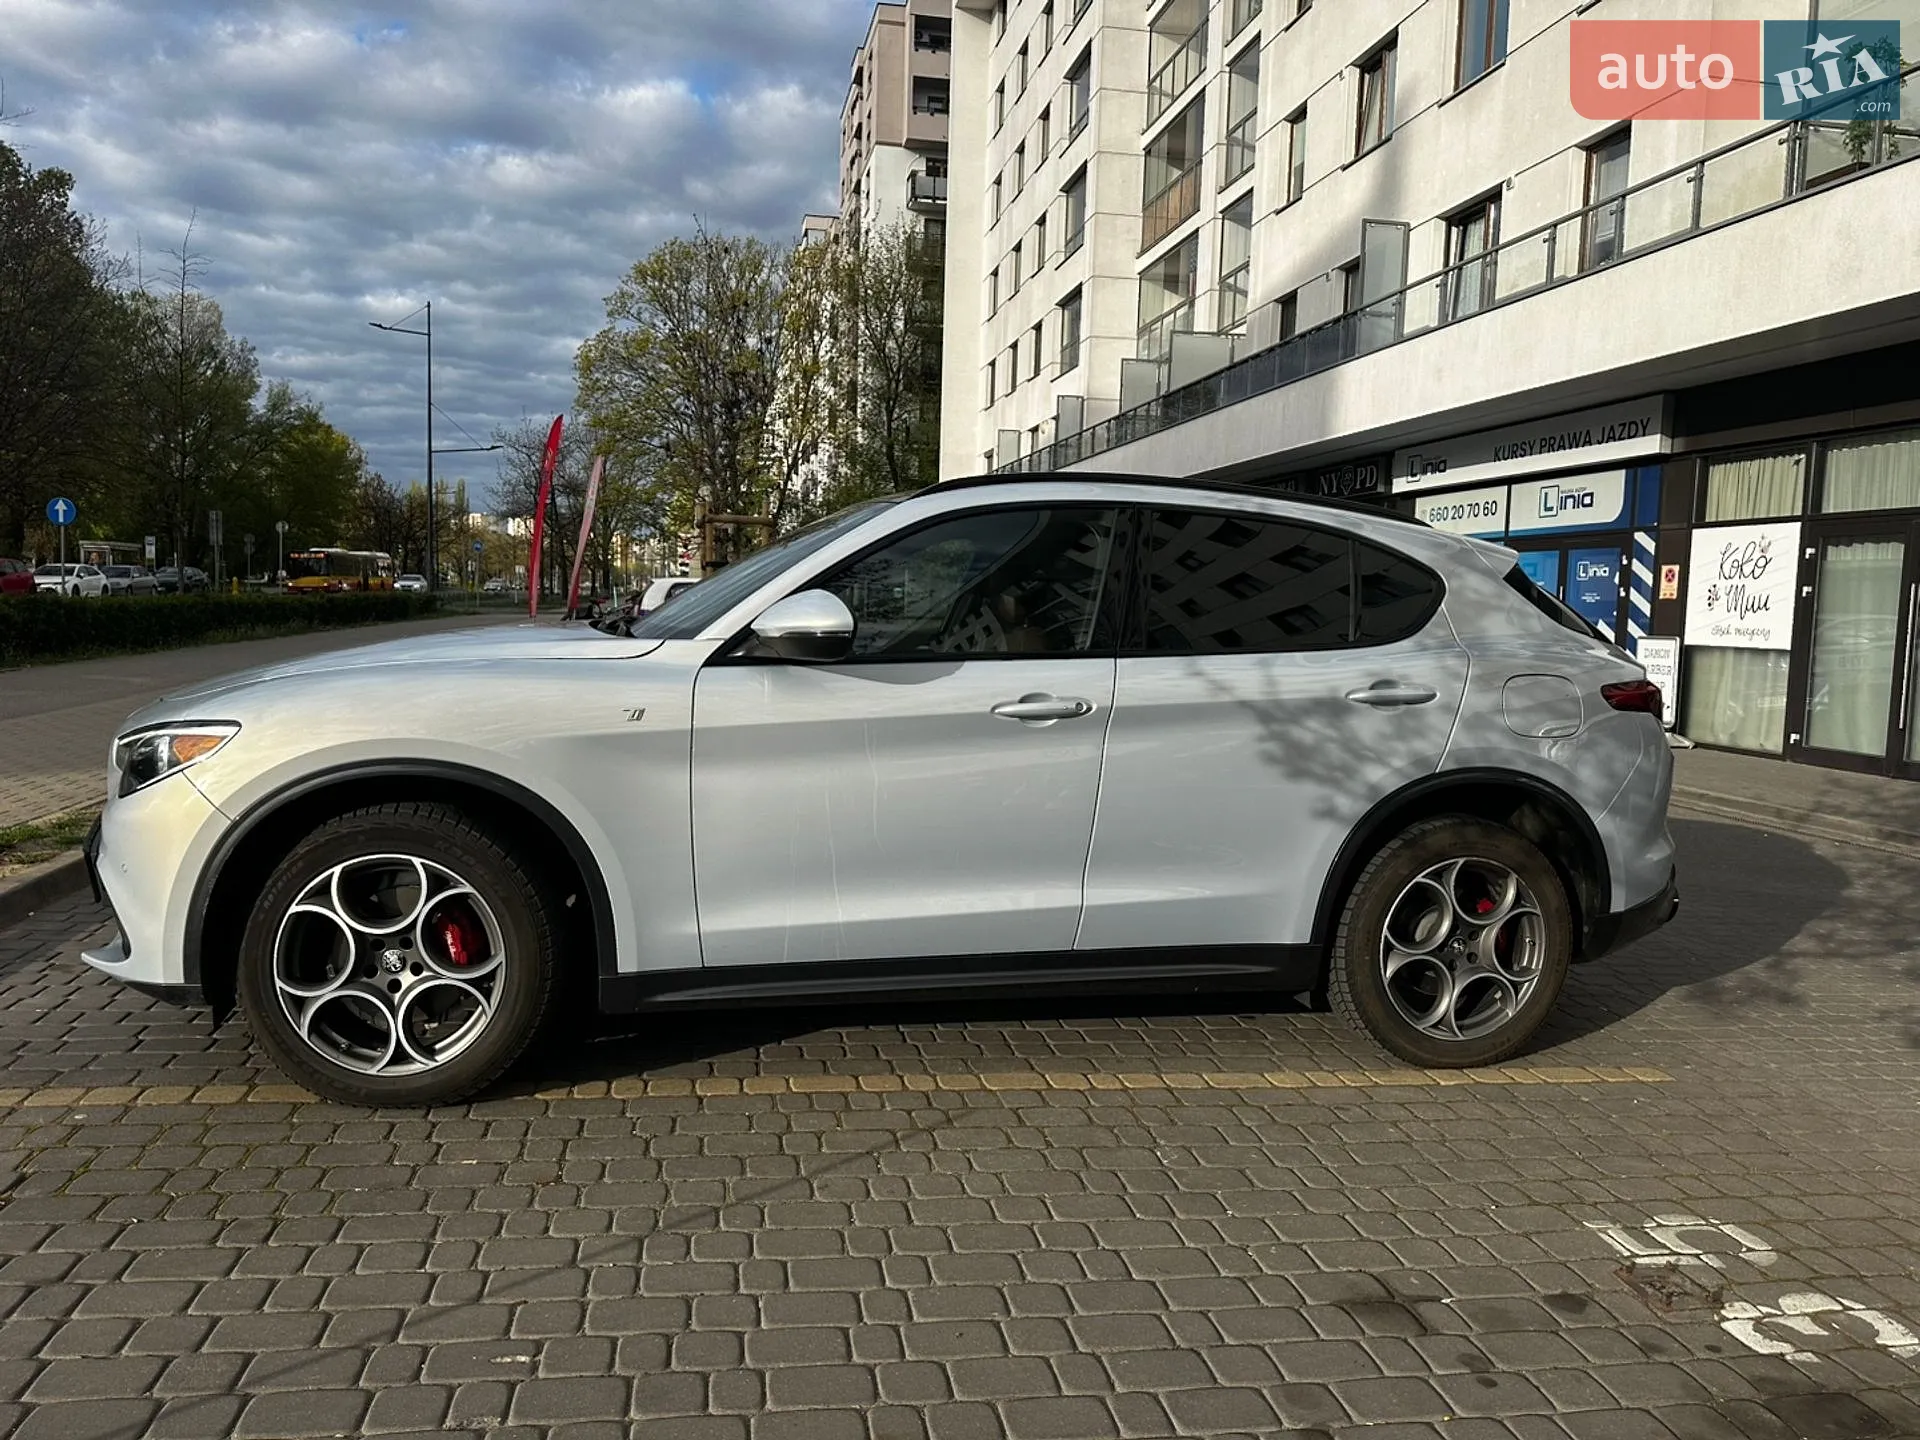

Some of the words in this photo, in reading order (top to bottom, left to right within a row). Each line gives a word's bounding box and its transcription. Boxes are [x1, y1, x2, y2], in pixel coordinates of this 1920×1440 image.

[1493, 439, 1537, 462] KURSY
[1539, 429, 1593, 455] PRAWA
[1597, 417, 1651, 445] JAZDY
[1429, 506, 1448, 523] 660
[1450, 504, 1464, 520] 20
[1466, 503, 1480, 519] 70
[1483, 500, 1498, 516] 60
[1540, 487, 1595, 516] Linia
